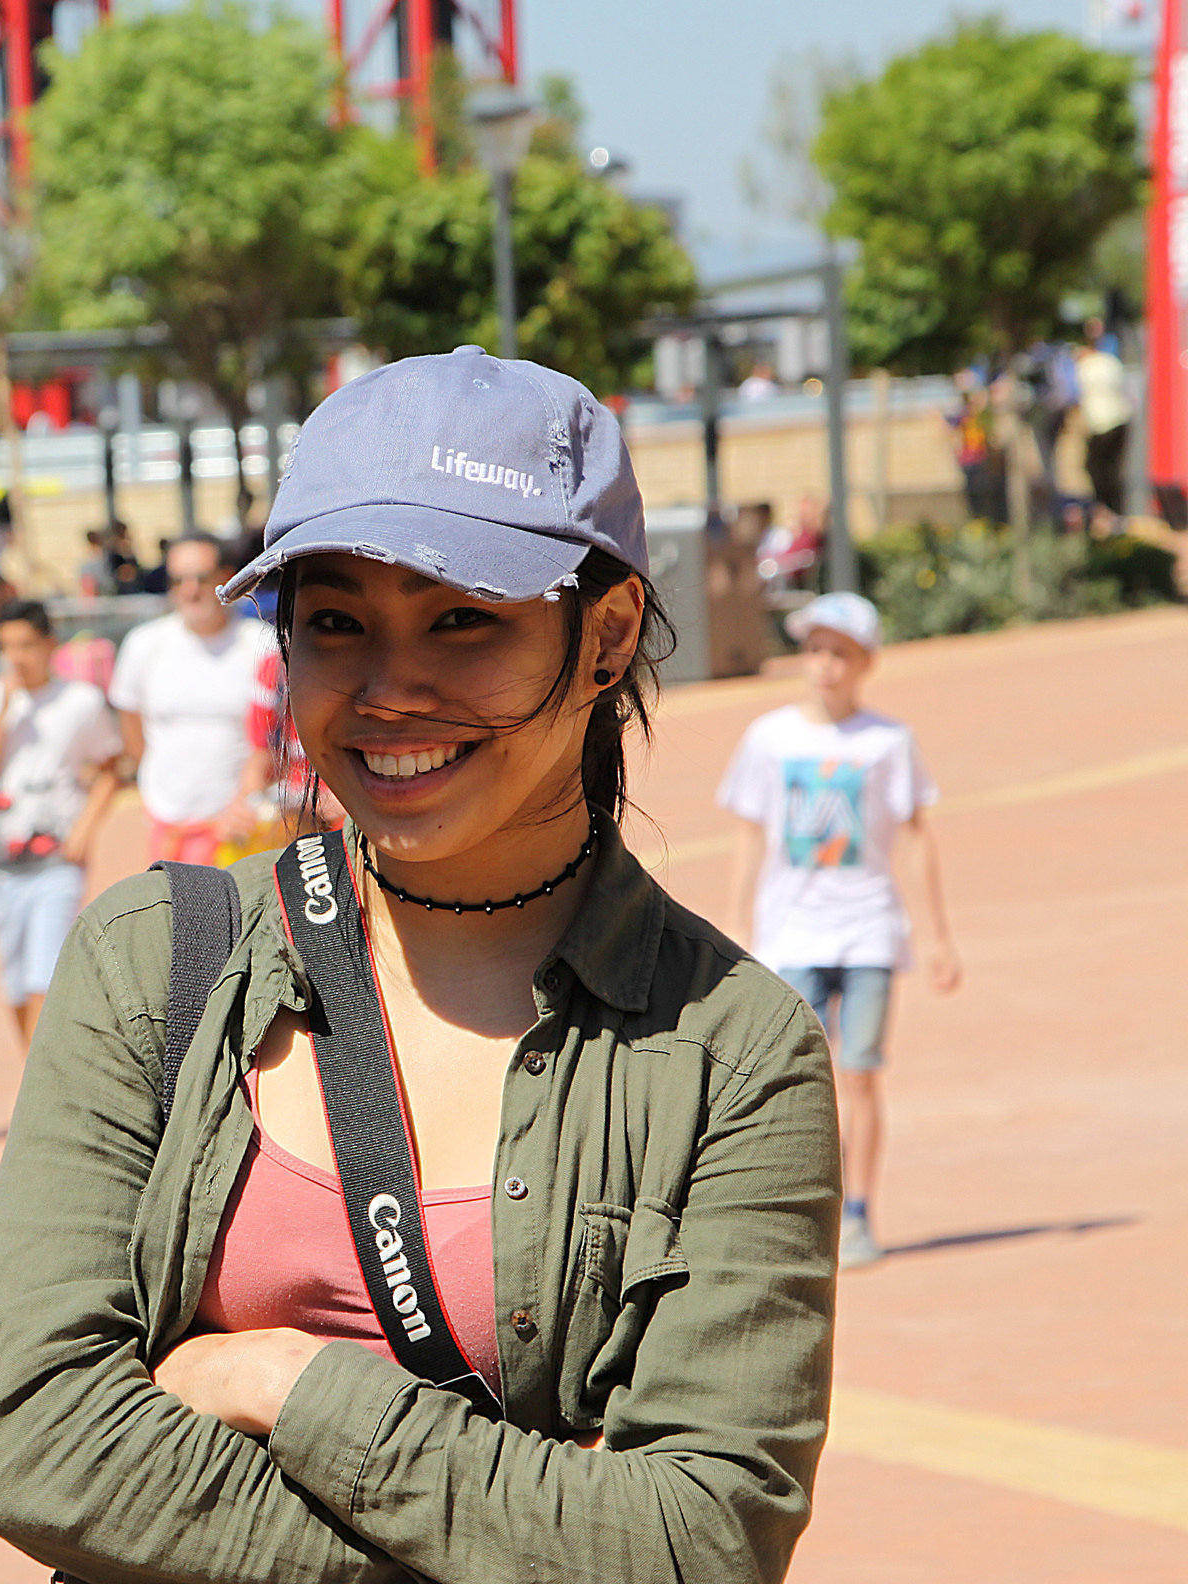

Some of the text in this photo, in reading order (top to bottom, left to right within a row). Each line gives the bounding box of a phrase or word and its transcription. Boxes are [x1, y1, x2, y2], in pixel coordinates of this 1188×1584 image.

[431, 445, 542, 498] Lifeway.
[296, 835, 339, 925] Canon
[368, 1193, 432, 1343] Canon
